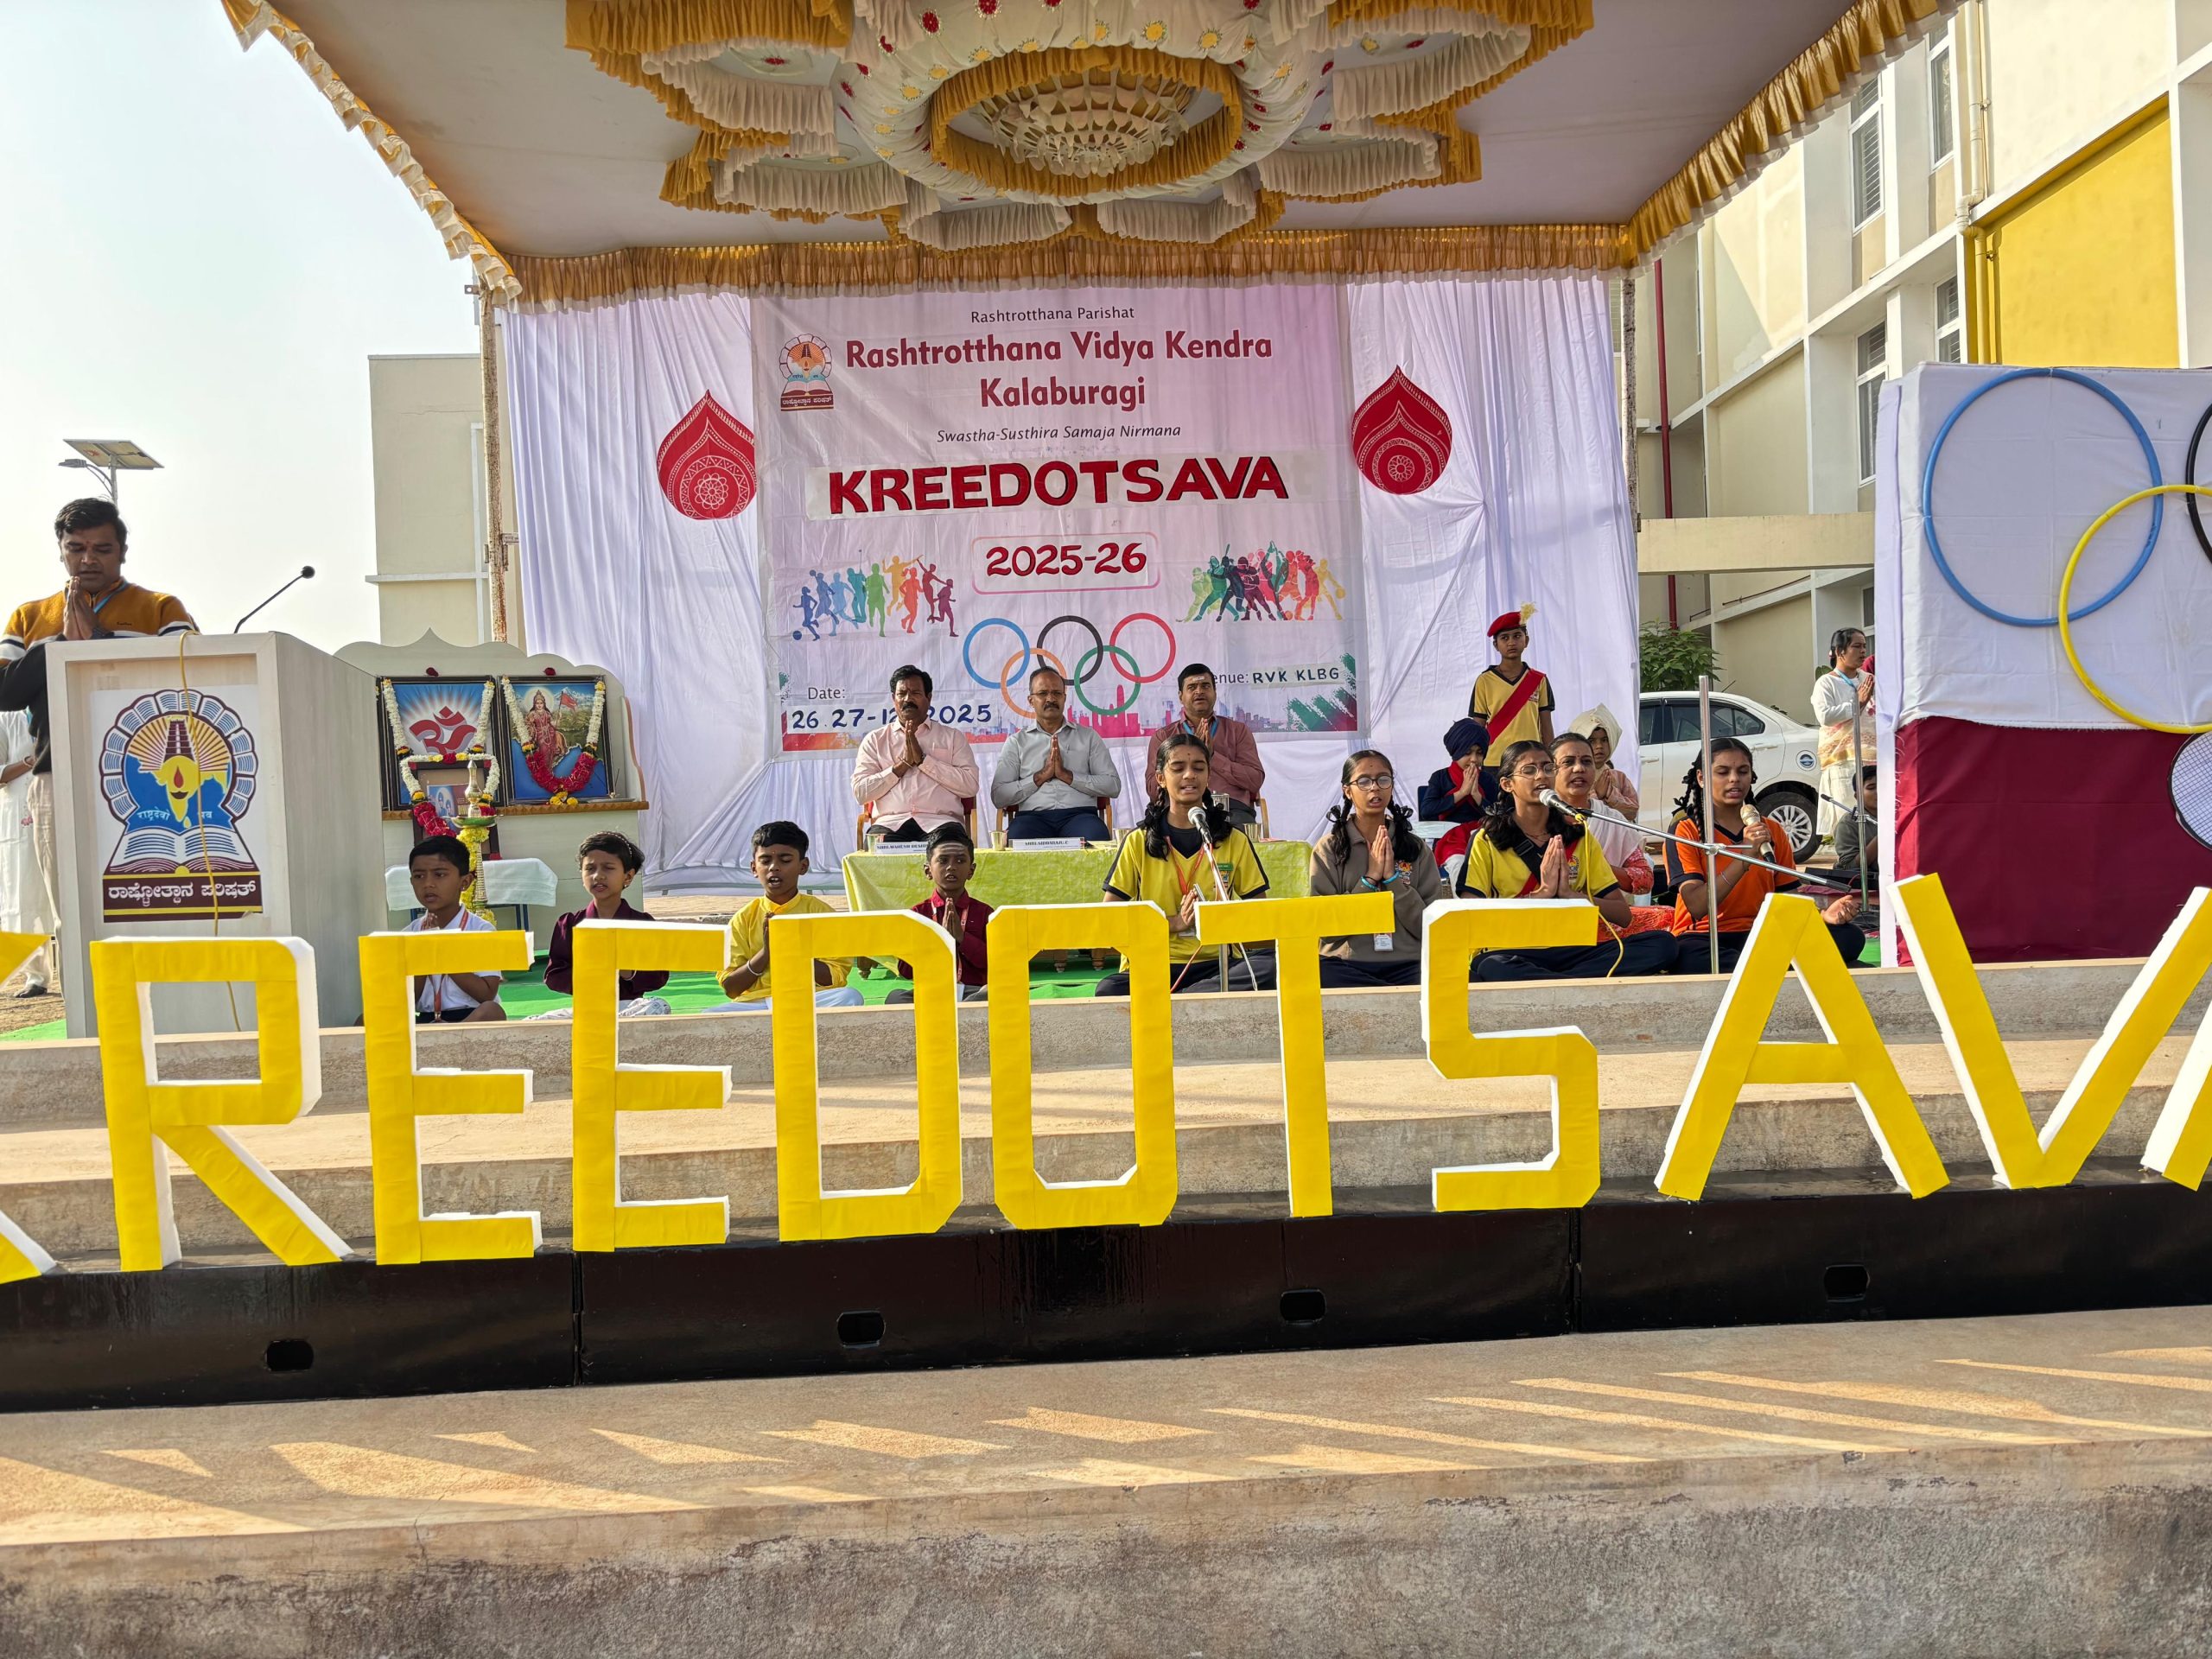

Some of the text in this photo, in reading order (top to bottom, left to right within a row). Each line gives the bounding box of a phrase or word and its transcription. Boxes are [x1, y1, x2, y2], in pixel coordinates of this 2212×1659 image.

[971, 306, 1135, 323] Rashtrotthana Parishat
[847, 329, 1273, 368] Rashtrotthana Vidya Kendra
[980, 376, 1146, 412] Kalaburagi
[937, 424, 1181, 443] Swastha-Susthira Samaja Nirmana
[829, 456, 1289, 515] KREEDOTSAVA
[986, 540, 1147, 578] 2025-26
[1213, 667, 1339, 684] enue: RVK KLBG
[808, 687, 846, 700] Date:
[200, 880, 257, 899] ಪರಿಷತ್
[0, 873, 2212, 1283] REEDOTSAV
